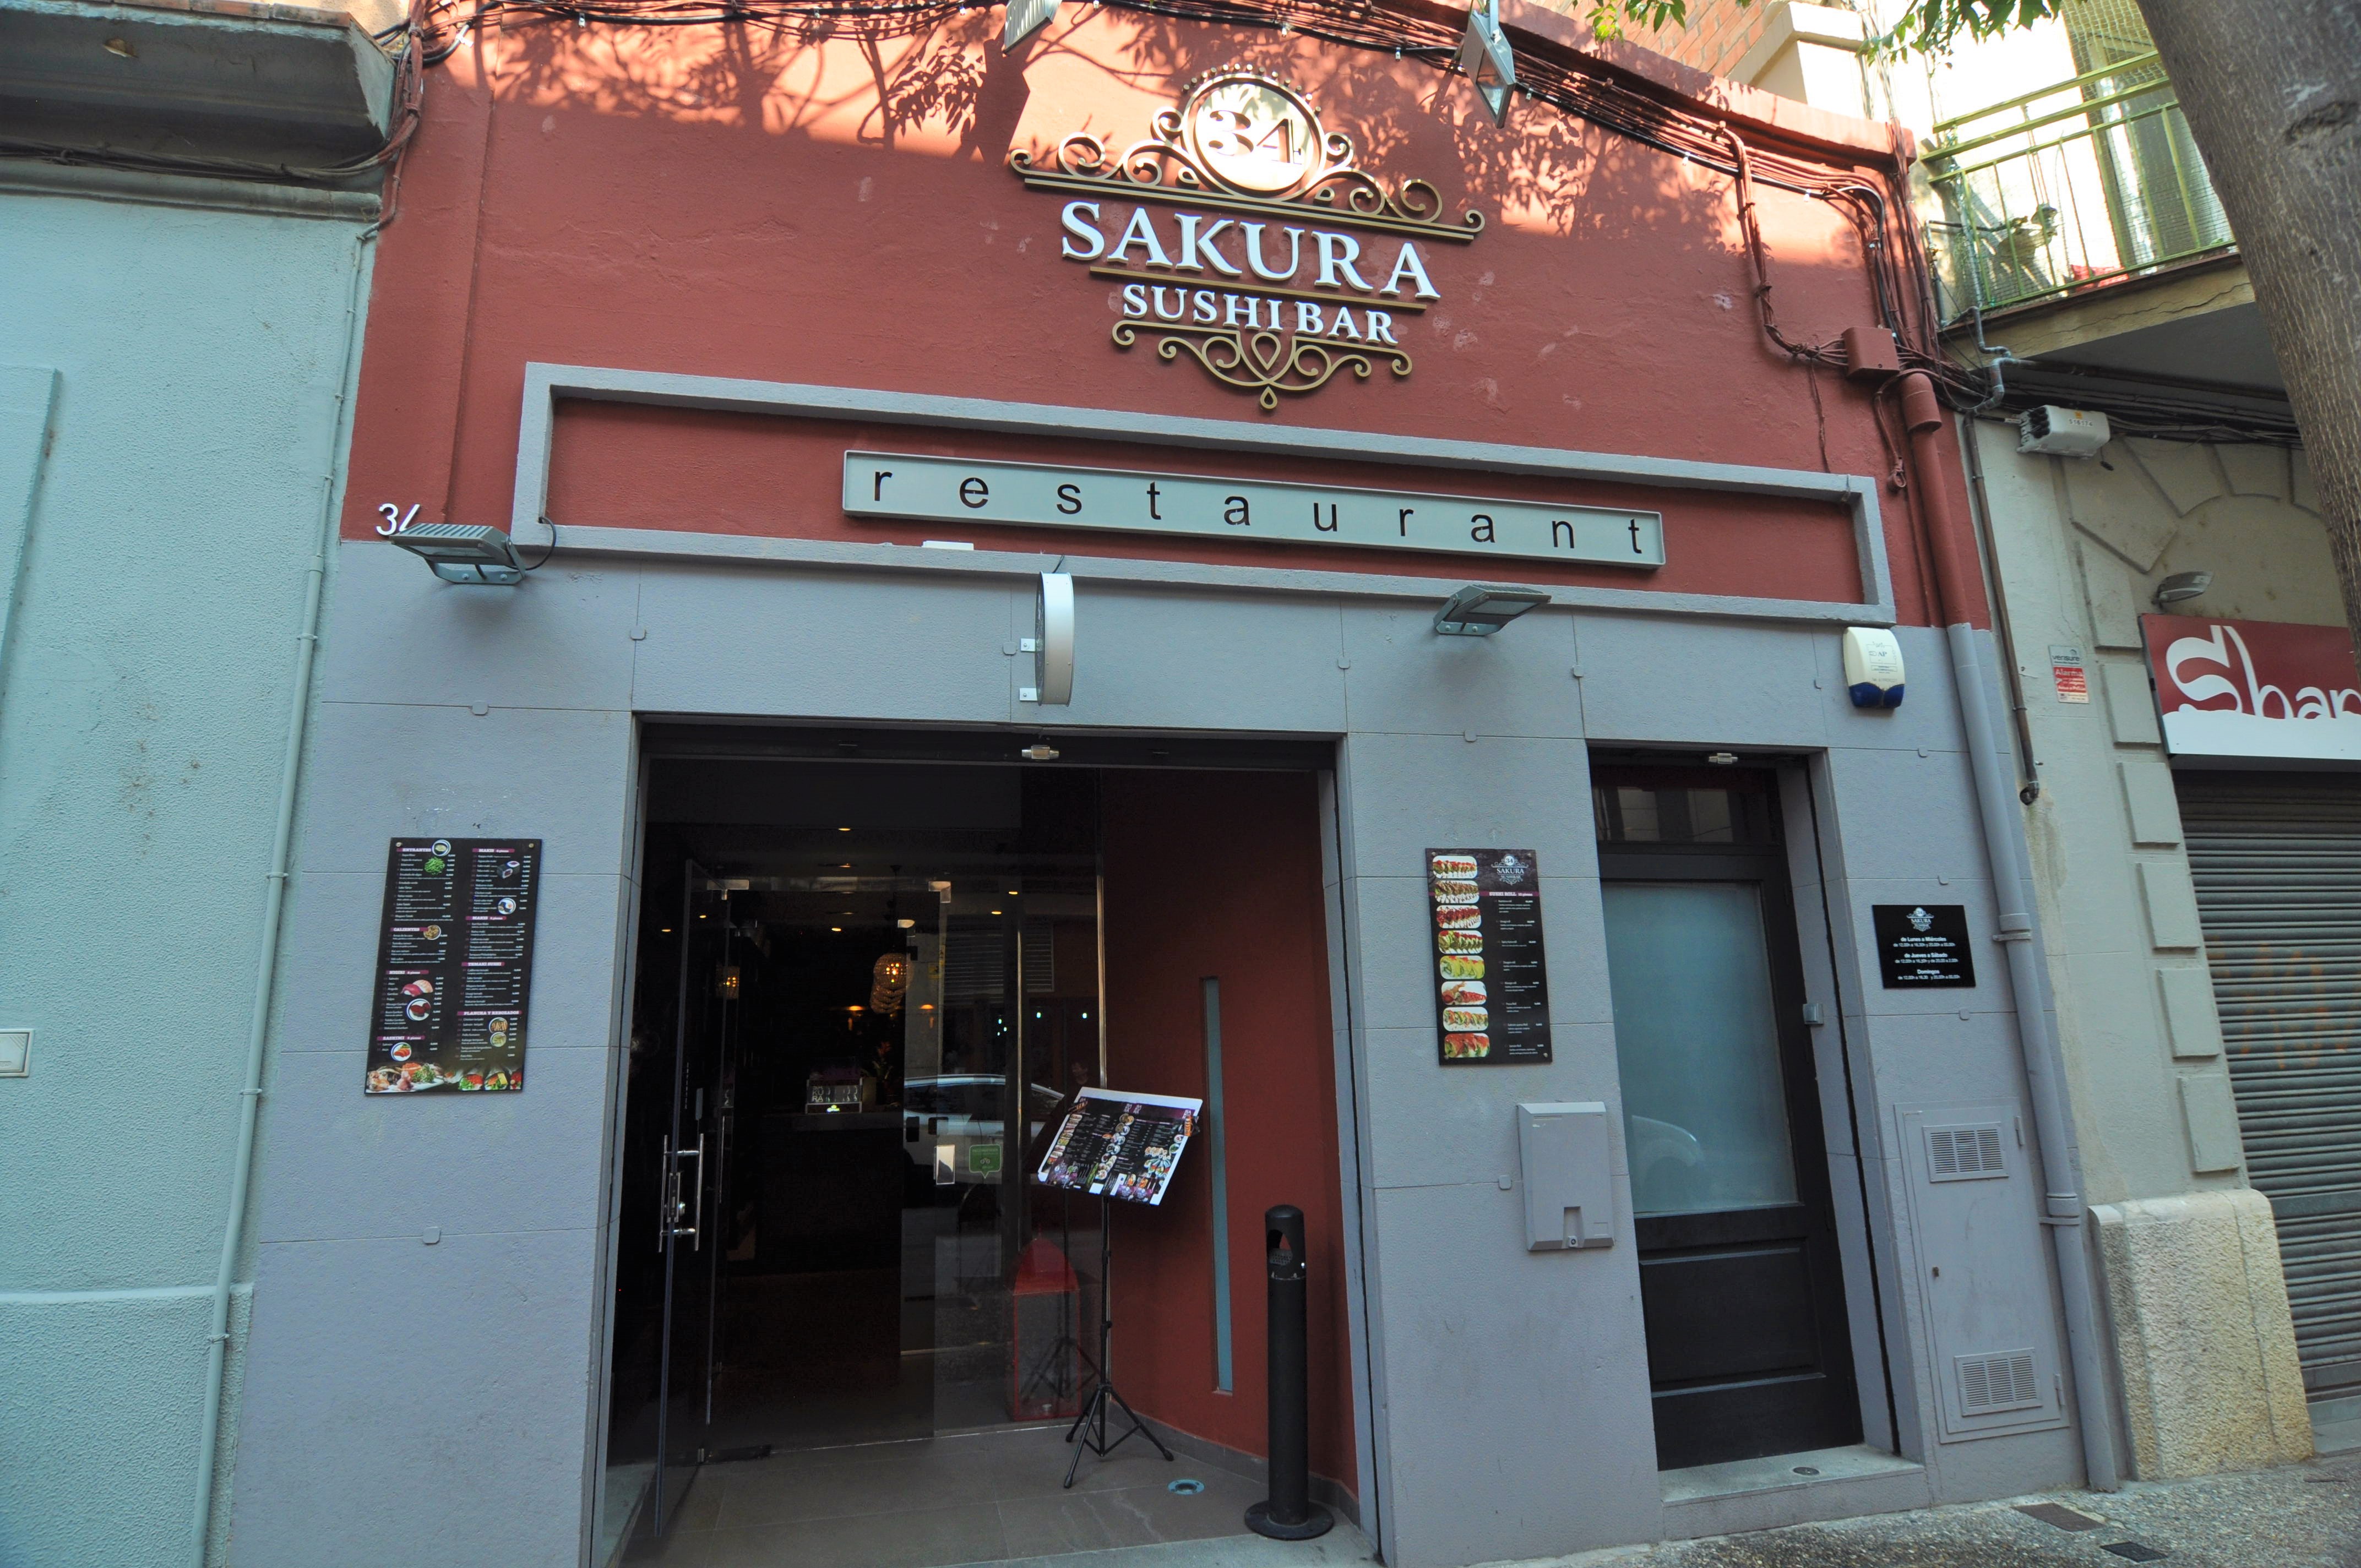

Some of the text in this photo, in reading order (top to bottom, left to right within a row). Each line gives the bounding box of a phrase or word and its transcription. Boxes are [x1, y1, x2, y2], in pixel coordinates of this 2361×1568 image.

[1208, 110, 1302, 166] 34
[1060, 201, 1441, 301] SAKURA
[1122, 284, 1399, 346] SUSHI BAR
[873, 471, 1644, 555] restaurant
[2055, 668, 2083, 677] Alarma
